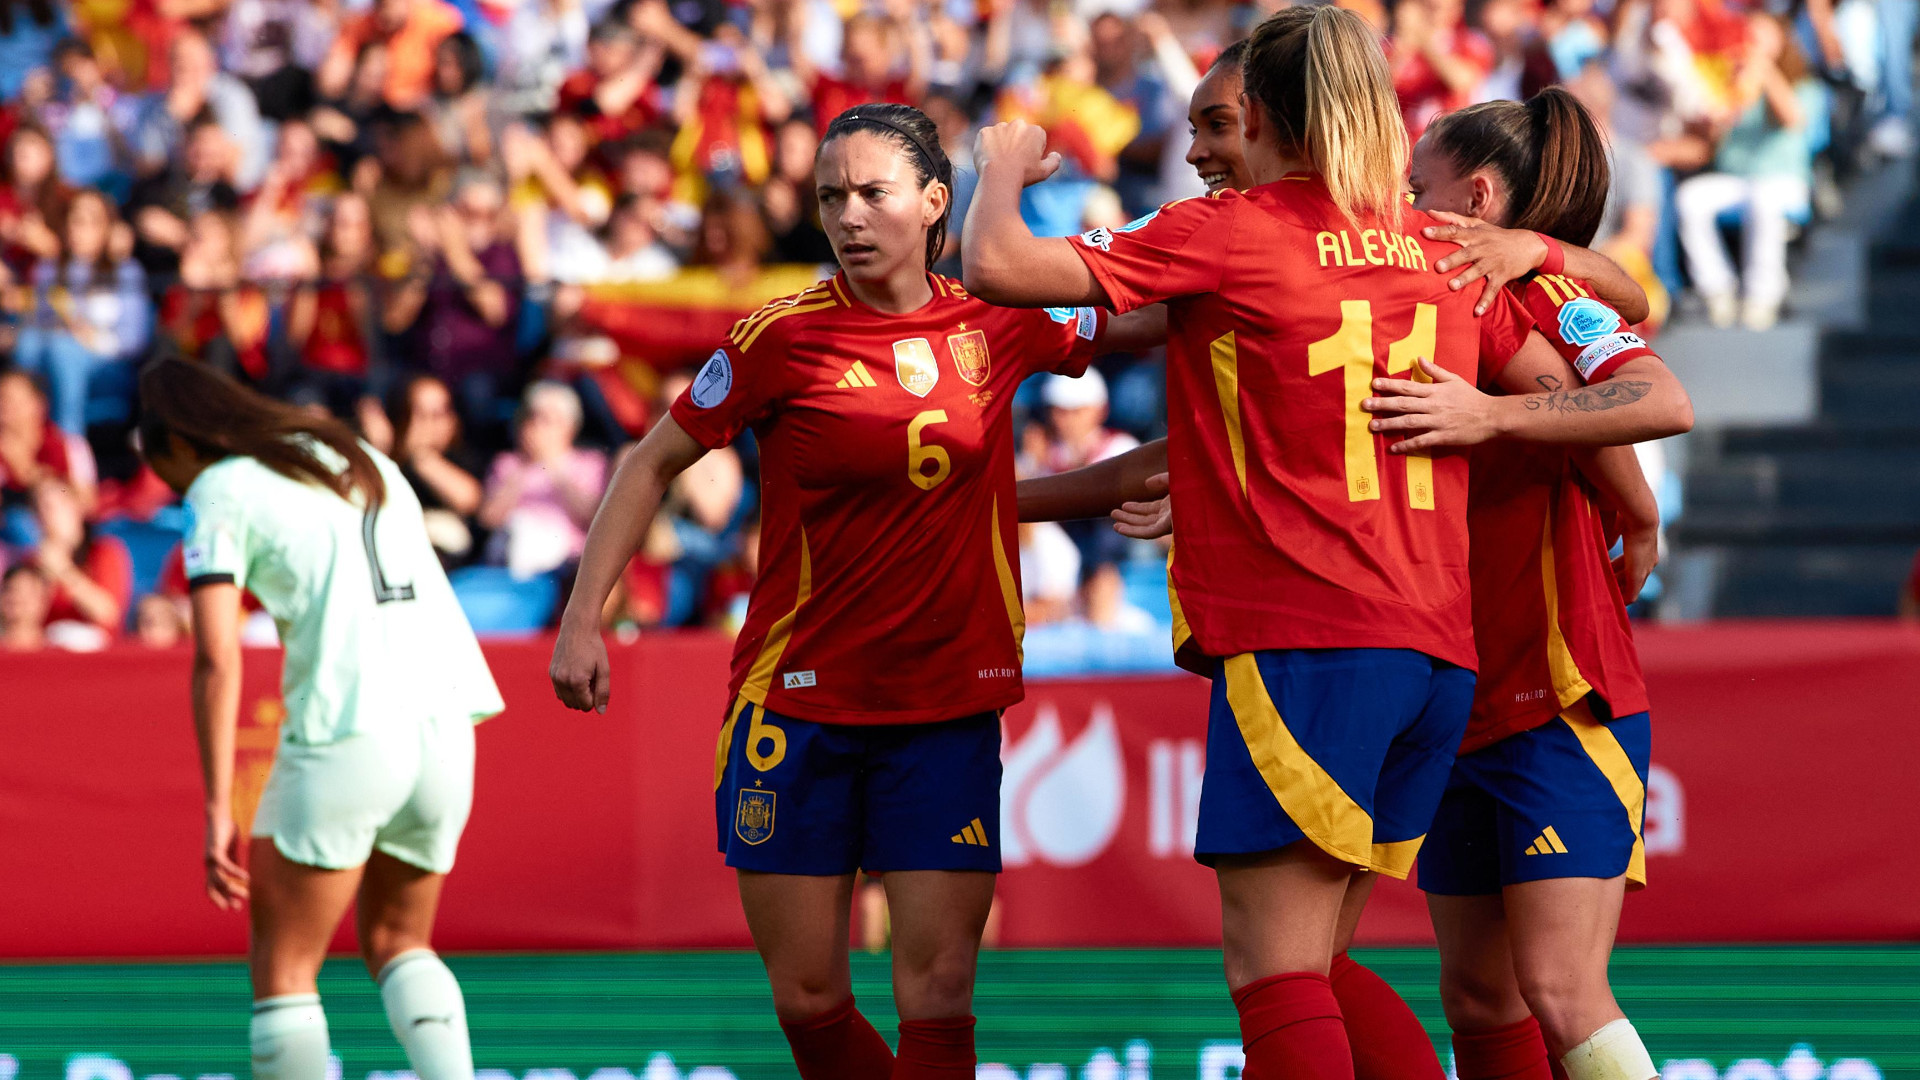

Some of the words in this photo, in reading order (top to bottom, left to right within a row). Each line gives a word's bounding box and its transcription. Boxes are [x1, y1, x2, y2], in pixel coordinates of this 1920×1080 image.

[1316, 229, 1428, 272] ALEXIA
[1579, 340, 1620, 372] FOUNDATION
[910, 373, 929, 383] FIFA
[1308, 300, 1437, 511] 11
[907, 409, 951, 491] 6
[978, 668, 1015, 679] HEAT.RDY
[746, 704, 787, 772] 6
